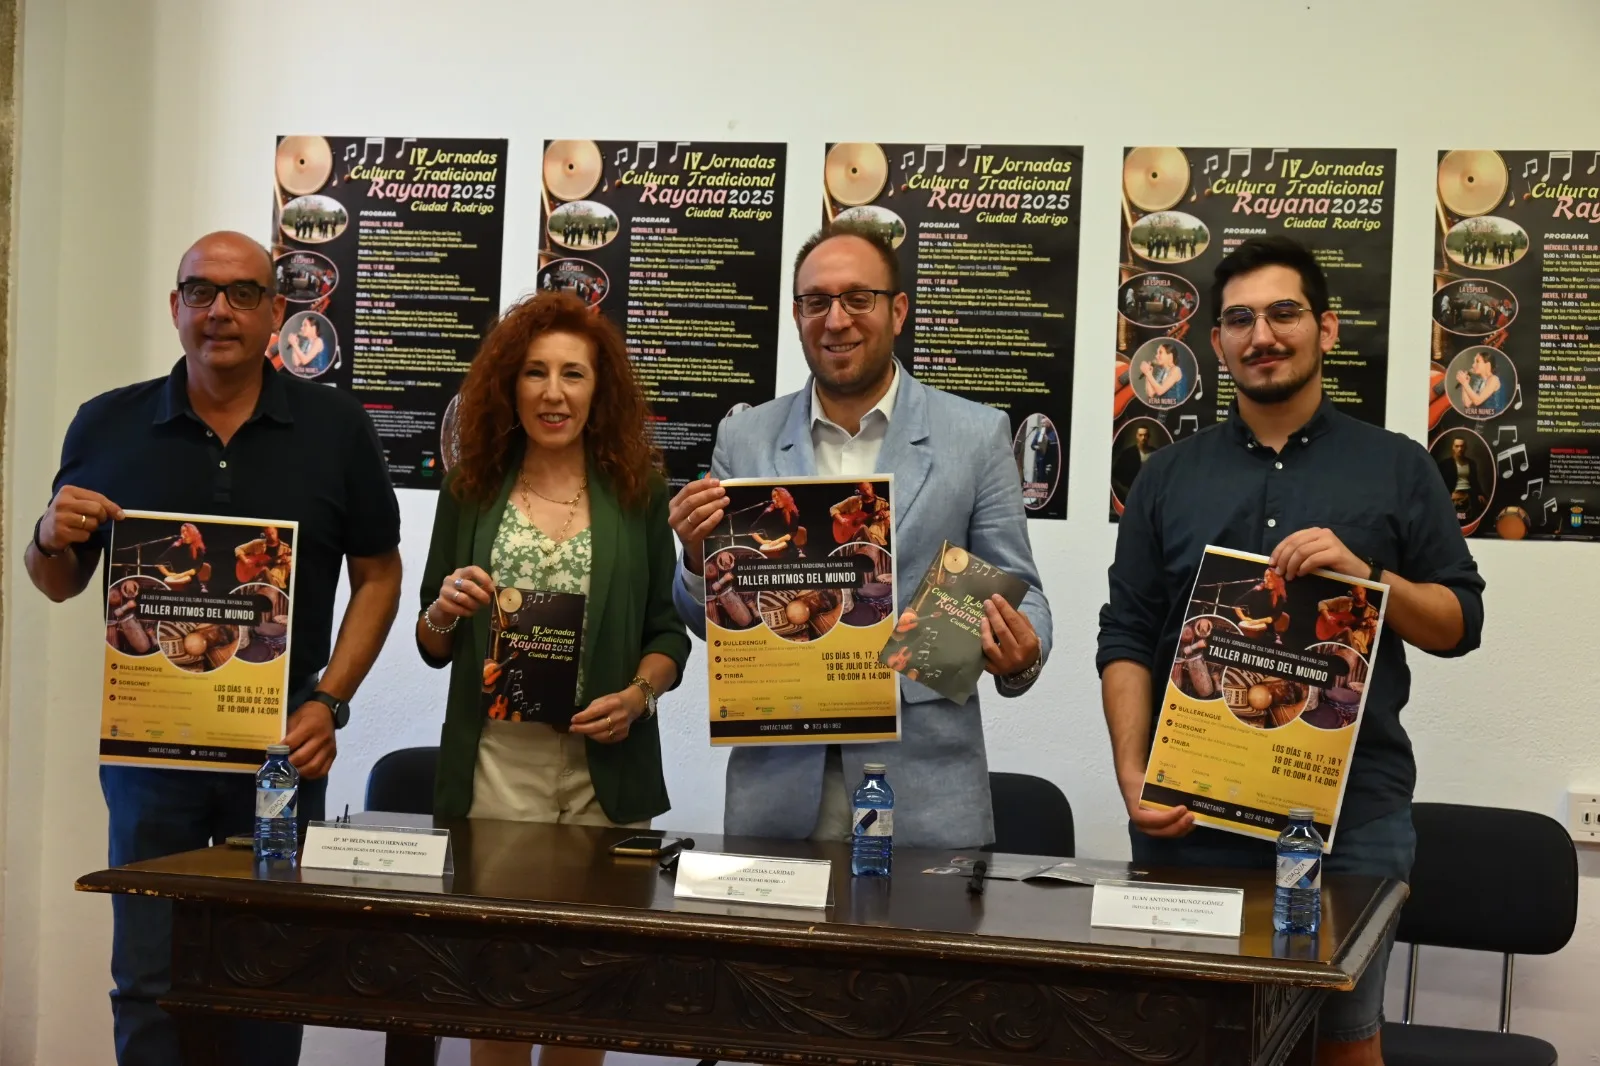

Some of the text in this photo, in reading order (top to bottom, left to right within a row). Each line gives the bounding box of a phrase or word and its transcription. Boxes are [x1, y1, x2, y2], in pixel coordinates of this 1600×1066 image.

[410, 147, 497, 166] IV Jornadas
[683, 151, 776, 171] IV Jornadas
[973, 155, 1072, 175] IV Jornadas
[1281, 159, 1384, 179] IV Jornadas
[350, 165, 497, 182] Cultura Tradicional
[621, 170, 776, 187] Cultura Tradicional
[909, 174, 1072, 191] Cultura Tradicional
[1212, 178, 1384, 196] Cultura Tradicional
[1531, 182, 1600, 199] Cultura
[411, 200, 494, 215] Ciudad Rodrigo
[685, 207, 773, 221] Ciudad Rodrigo
[976, 211, 1069, 226] Ciudad Rodrigo
[1283, 216, 1381, 232] Ciudad Rodrigo
[1223, 228, 1267, 236] PROGRAMA
[1544, 233, 1589, 241] PROGRAMA
[1466, 286, 1488, 294] ESPUELA
[737, 571, 856, 586] TALLER RITMOS DEL MUNDO
[931, 587, 959, 605] Cultura
[139, 603, 254, 621] TALLER RITMOS DEL MUNDO
[935, 597, 977, 625] Rayana
[532, 625, 575, 637] IV Jornadas
[949, 617, 970, 631] Ciudad
[500, 631, 575, 645] Cultura Tradicional
[508, 638, 552, 651] Rayana
[722, 639, 767, 647] BULLERENGUE
[550, 653, 573, 662] Rodrigo
[822, 652, 834, 661] LOS
[835, 650, 850, 660] DÍAS
[1256, 645, 1275, 655] CULTURA
[1275, 649, 1300, 661] TRADICIONAL
[119, 664, 163, 673] BULLERENGUE
[845, 662, 863, 670] JULIO
[864, 662, 872, 670] DE
[1208, 645, 1328, 682] TALLER RITMOS DEL MUNDO
[827, 673, 835, 681] DE
[861, 672, 867, 680] A
[214, 684, 226, 692] LOS
[227, 683, 242, 693] DÍAS
[236, 696, 251, 704] JULIO
[264, 697, 280, 705] 2025
[250, 706, 256, 714] A
[1178, 705, 1222, 721] BULLERENGUE
[1174, 722, 1207, 734] SORSONET
[1170, 738, 1190, 749] TIRIBA
[1272, 744, 1285, 754] LOS
[1286, 746, 1301, 758] DÍAS
[1328, 756, 1336, 765] 18
[1337, 758, 1343, 766] Y
[1274, 755, 1340, 777] 19 DE JULIO DE 2025
[1272, 766, 1281, 775] DE
[1307, 773, 1312, 782] A
[1283, 862, 1307, 884] VIDAQUA
[1149, 896, 1178, 904] ANTONIO
[1202, 899, 1225, 907] GÓMEZ
